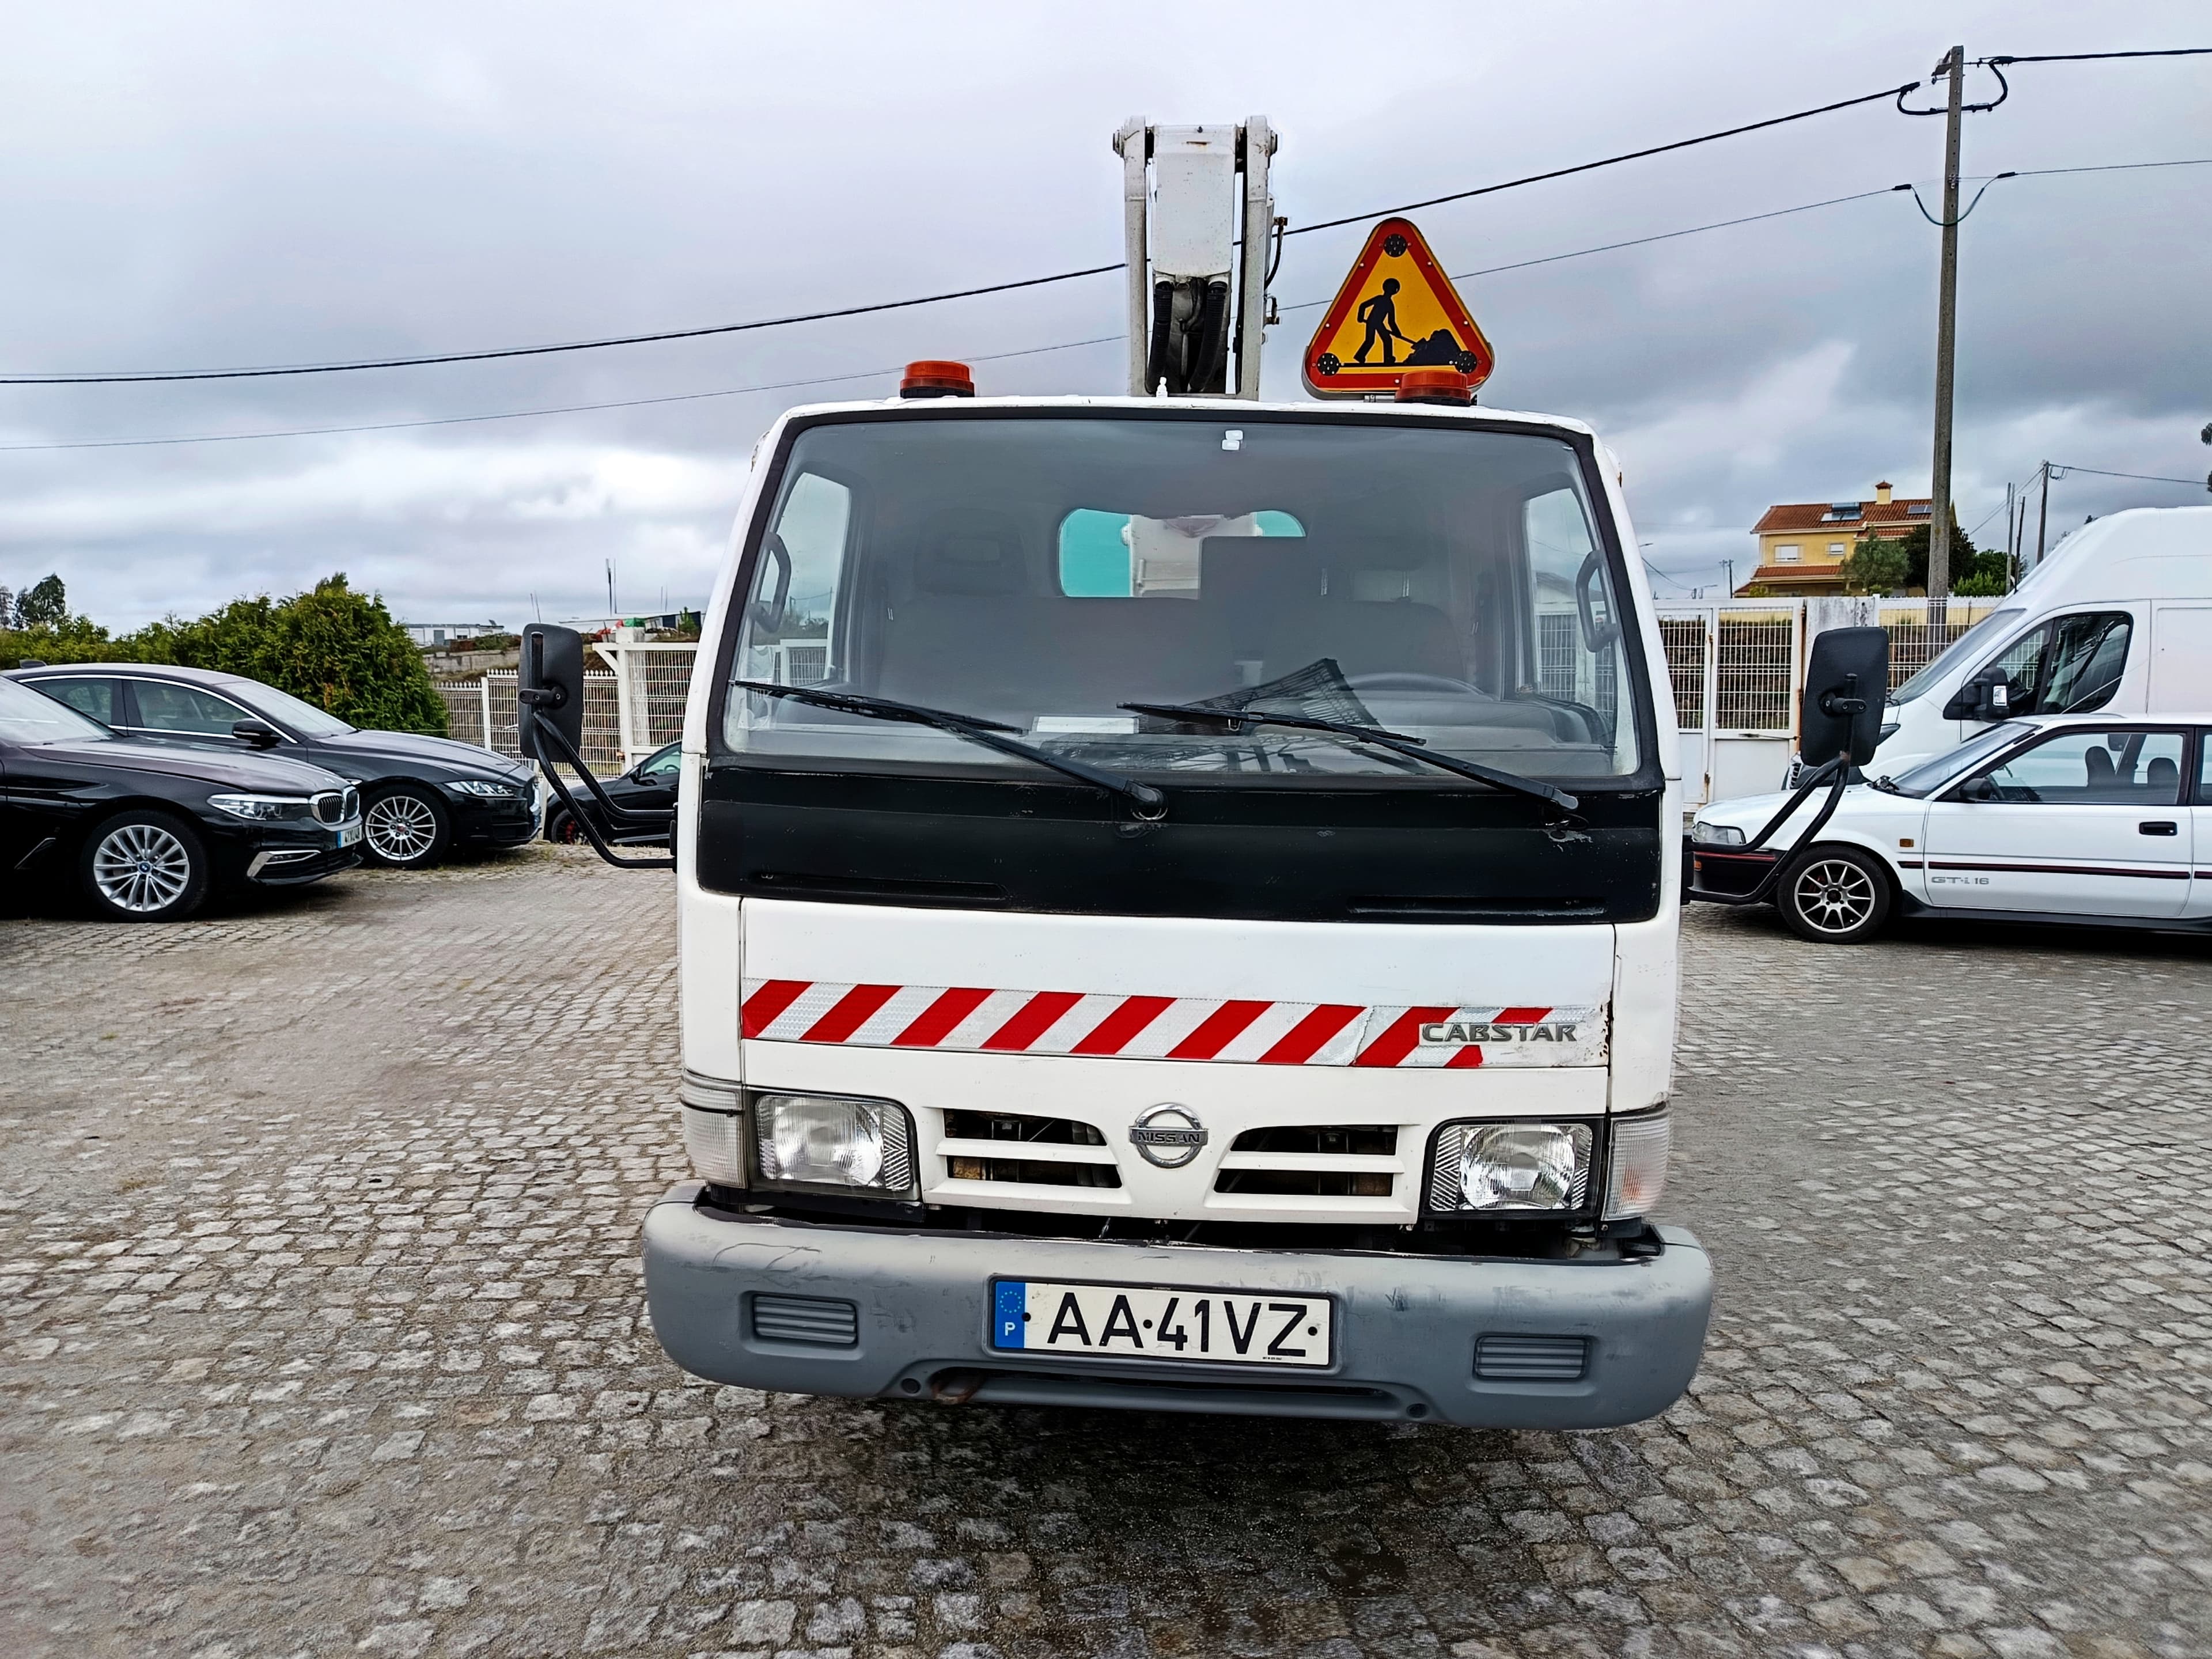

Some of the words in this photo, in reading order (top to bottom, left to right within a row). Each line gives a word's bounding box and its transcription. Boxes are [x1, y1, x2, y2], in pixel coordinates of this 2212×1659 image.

[1422, 1022, 1577, 1042] CABSTAR
[1138, 1131, 1200, 1143] NISSAN
[1005, 1321, 1016, 1336] P
